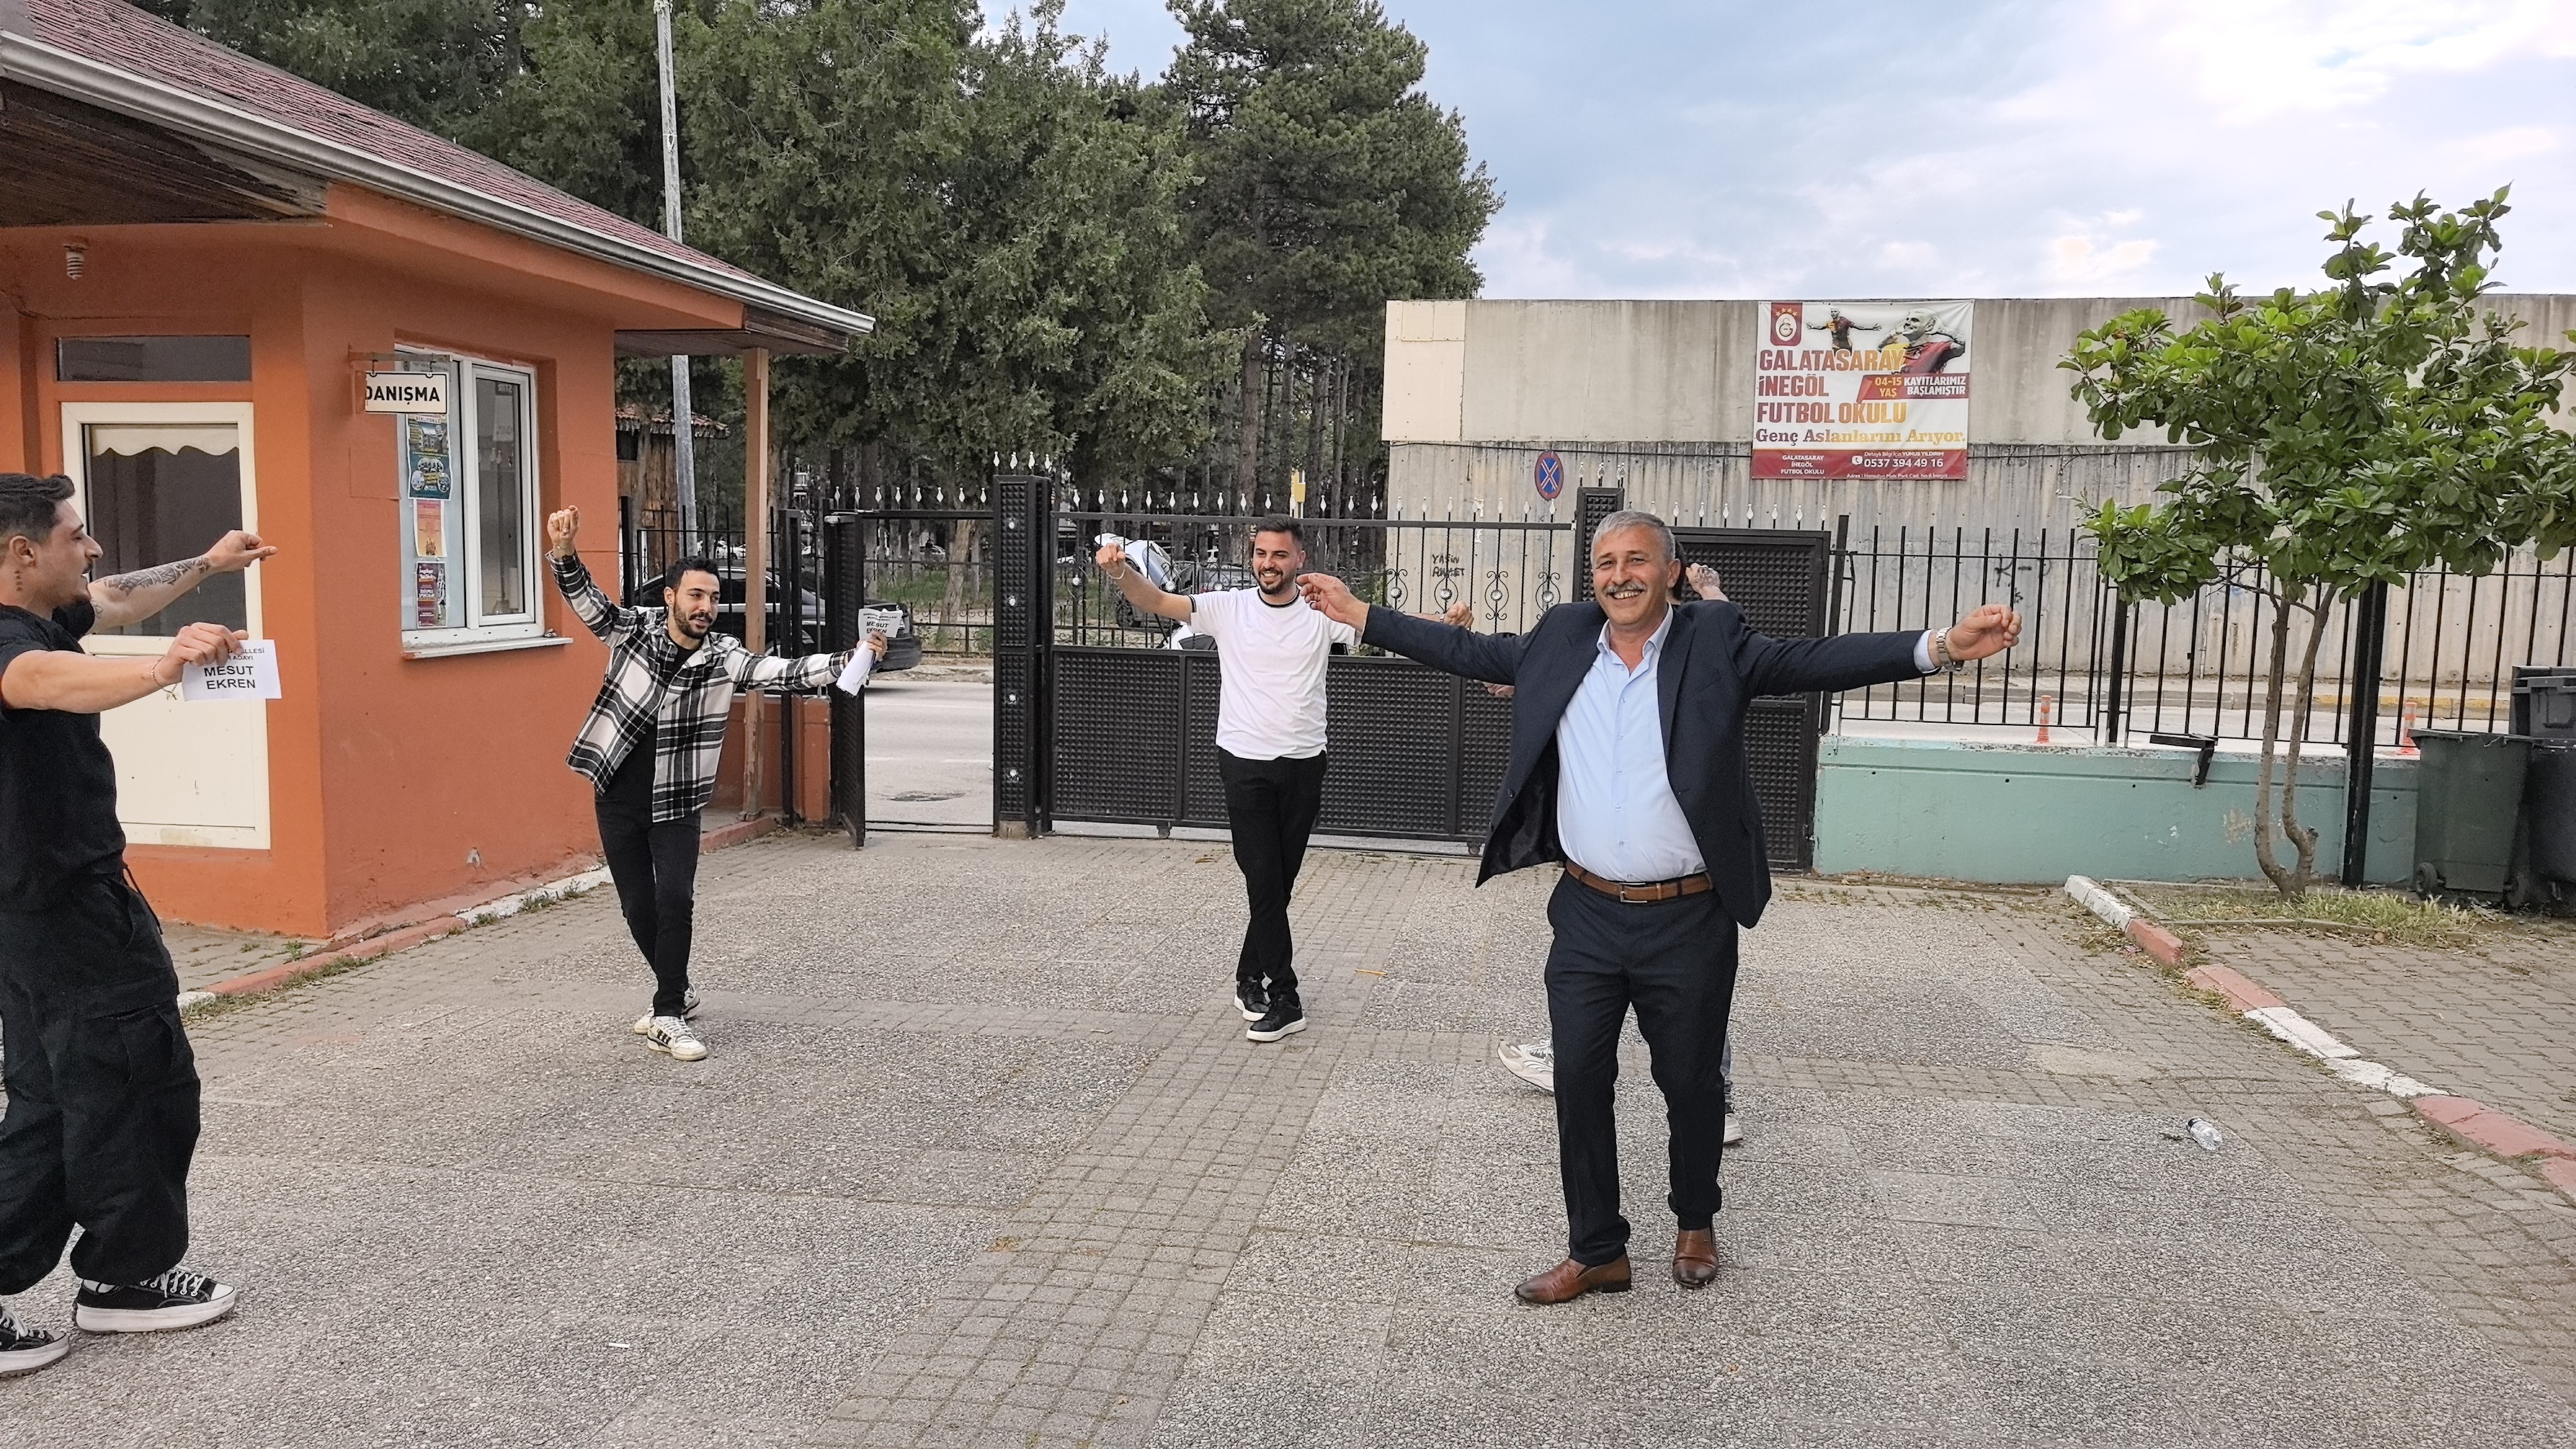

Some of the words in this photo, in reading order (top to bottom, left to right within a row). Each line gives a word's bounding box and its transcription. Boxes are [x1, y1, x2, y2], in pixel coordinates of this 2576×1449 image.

[1760, 350, 1906, 371] GALATASARAY
[1758, 374, 1829, 397] İNEGÖL
[1875, 377, 1902, 386] 04-15
[1904, 375, 1967, 386] KAYITLARIMIZ
[365, 386, 440, 405] DANIŞMA
[1879, 387, 1897, 398] YAŞ
[1907, 386, 1965, 396] BAŞLAMIŞTIR
[1757, 402, 1835, 423] FUTBOL
[1838, 402, 1907, 423] OKULU
[1756, 428, 1798, 446] Genç
[1803, 429, 1902, 443] Aslanlarını
[1906, 429, 1965, 445] Arıyor.
[1863, 458, 1890, 467] 0537
[1892, 458, 1912, 467] 394
[1914, 458, 1928, 467] 49
[1931, 458, 1943, 467] 16
[204, 665, 254, 677] MESUT
[206, 679, 256, 689] EKREN
